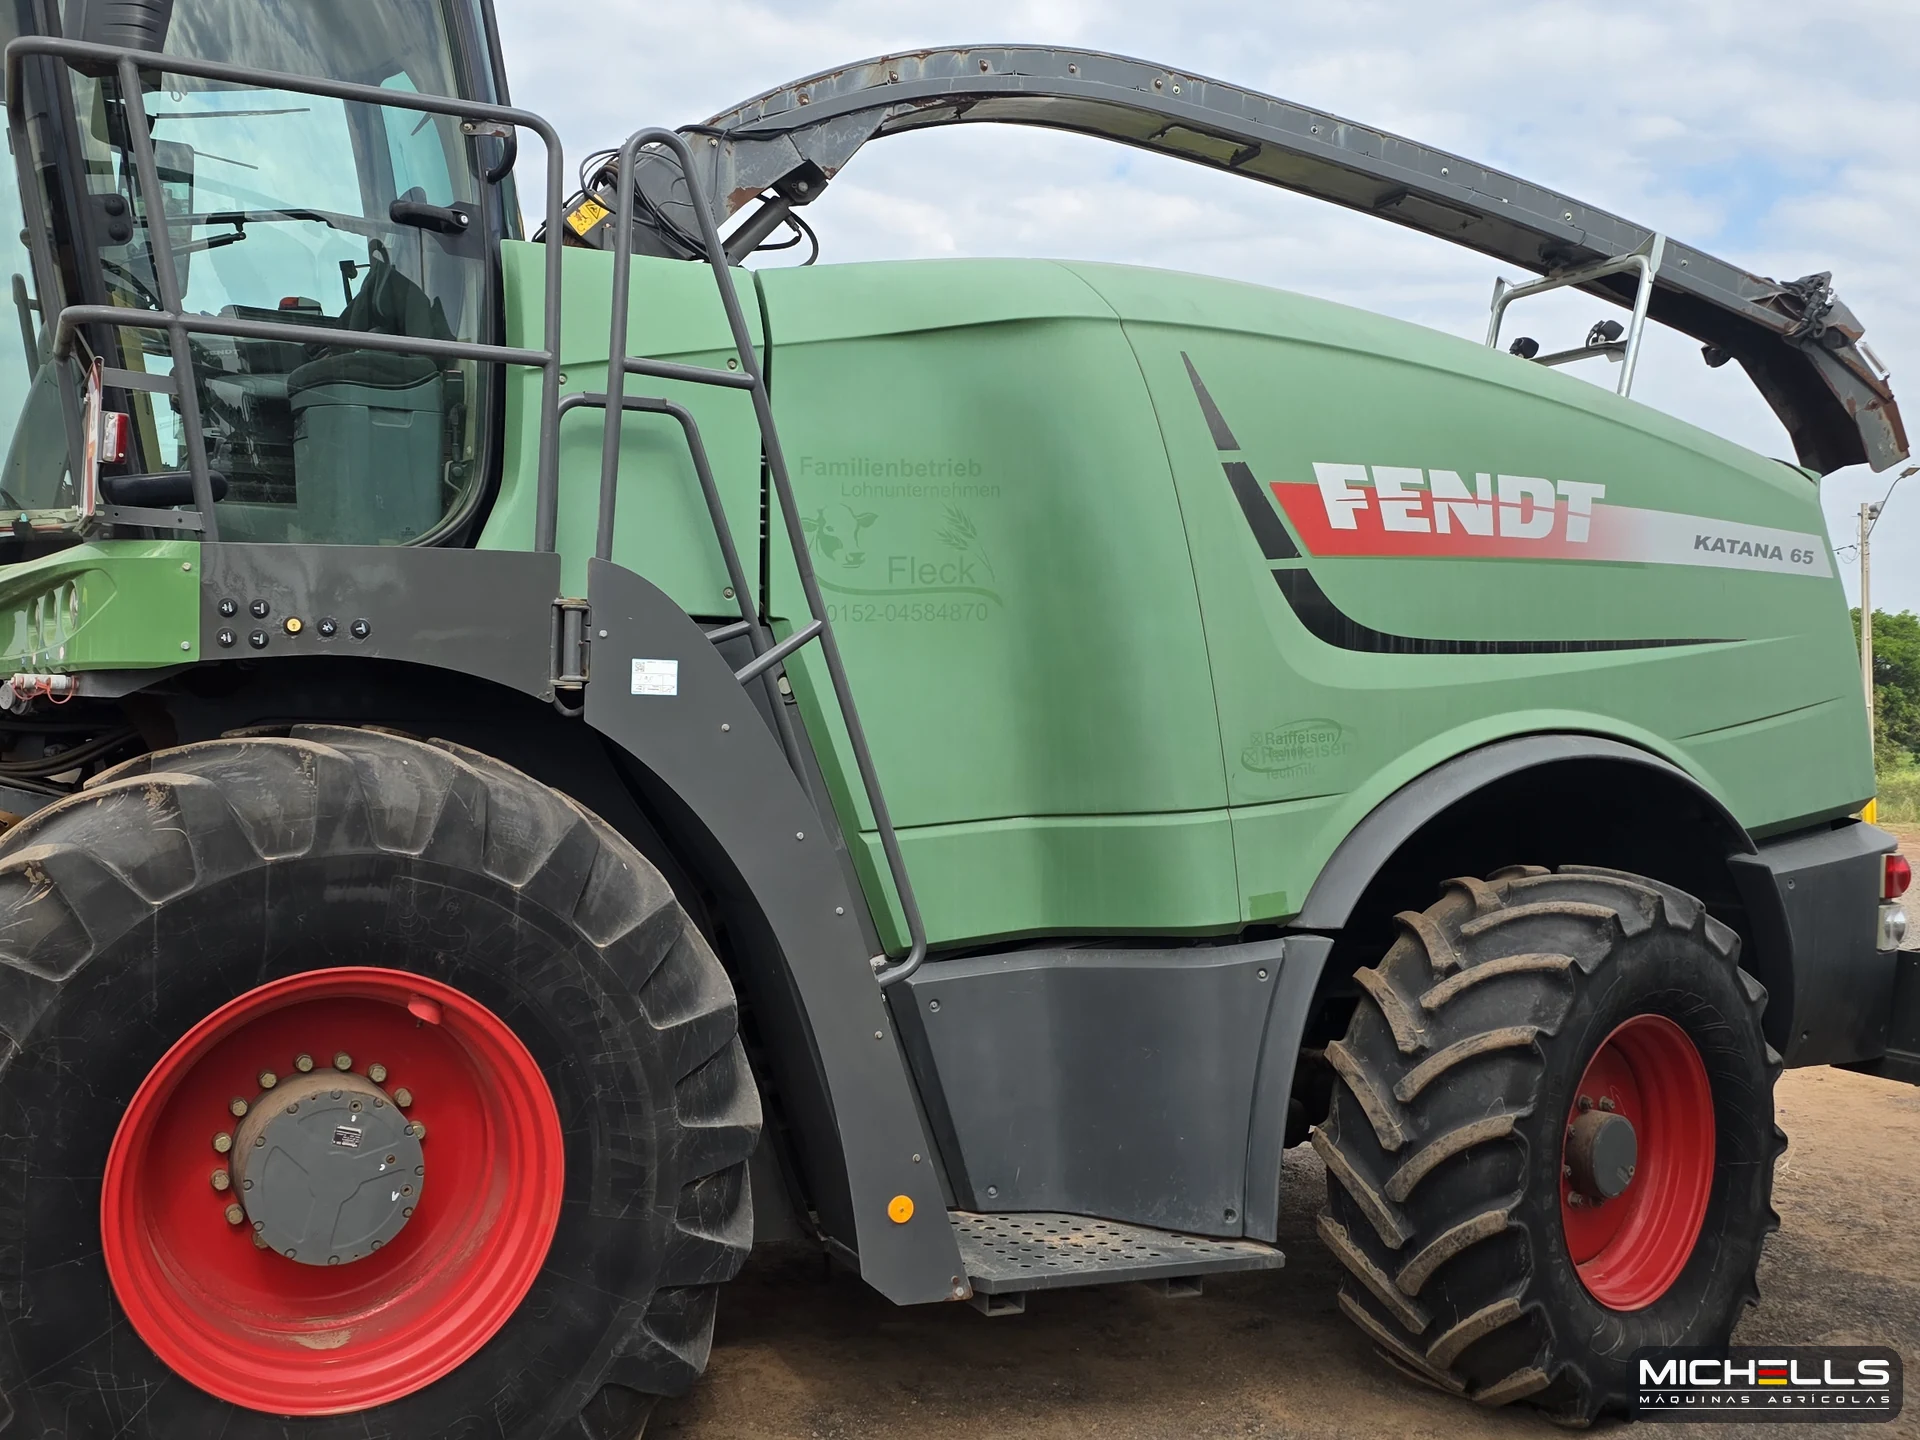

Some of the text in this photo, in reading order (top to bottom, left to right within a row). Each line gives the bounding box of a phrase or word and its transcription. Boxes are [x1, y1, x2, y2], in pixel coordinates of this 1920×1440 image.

[800, 456, 982, 477] Familienbetrieb
[841, 482, 1000, 498] Lohnunternehmen
[1312, 462, 1605, 542] FENDT
[1694, 534, 1814, 565] KATANA 65
[888, 555, 975, 585] Fleck
[826, 603, 988, 623] 0152-04584870
[1265, 729, 1335, 745] Raiffeisen
